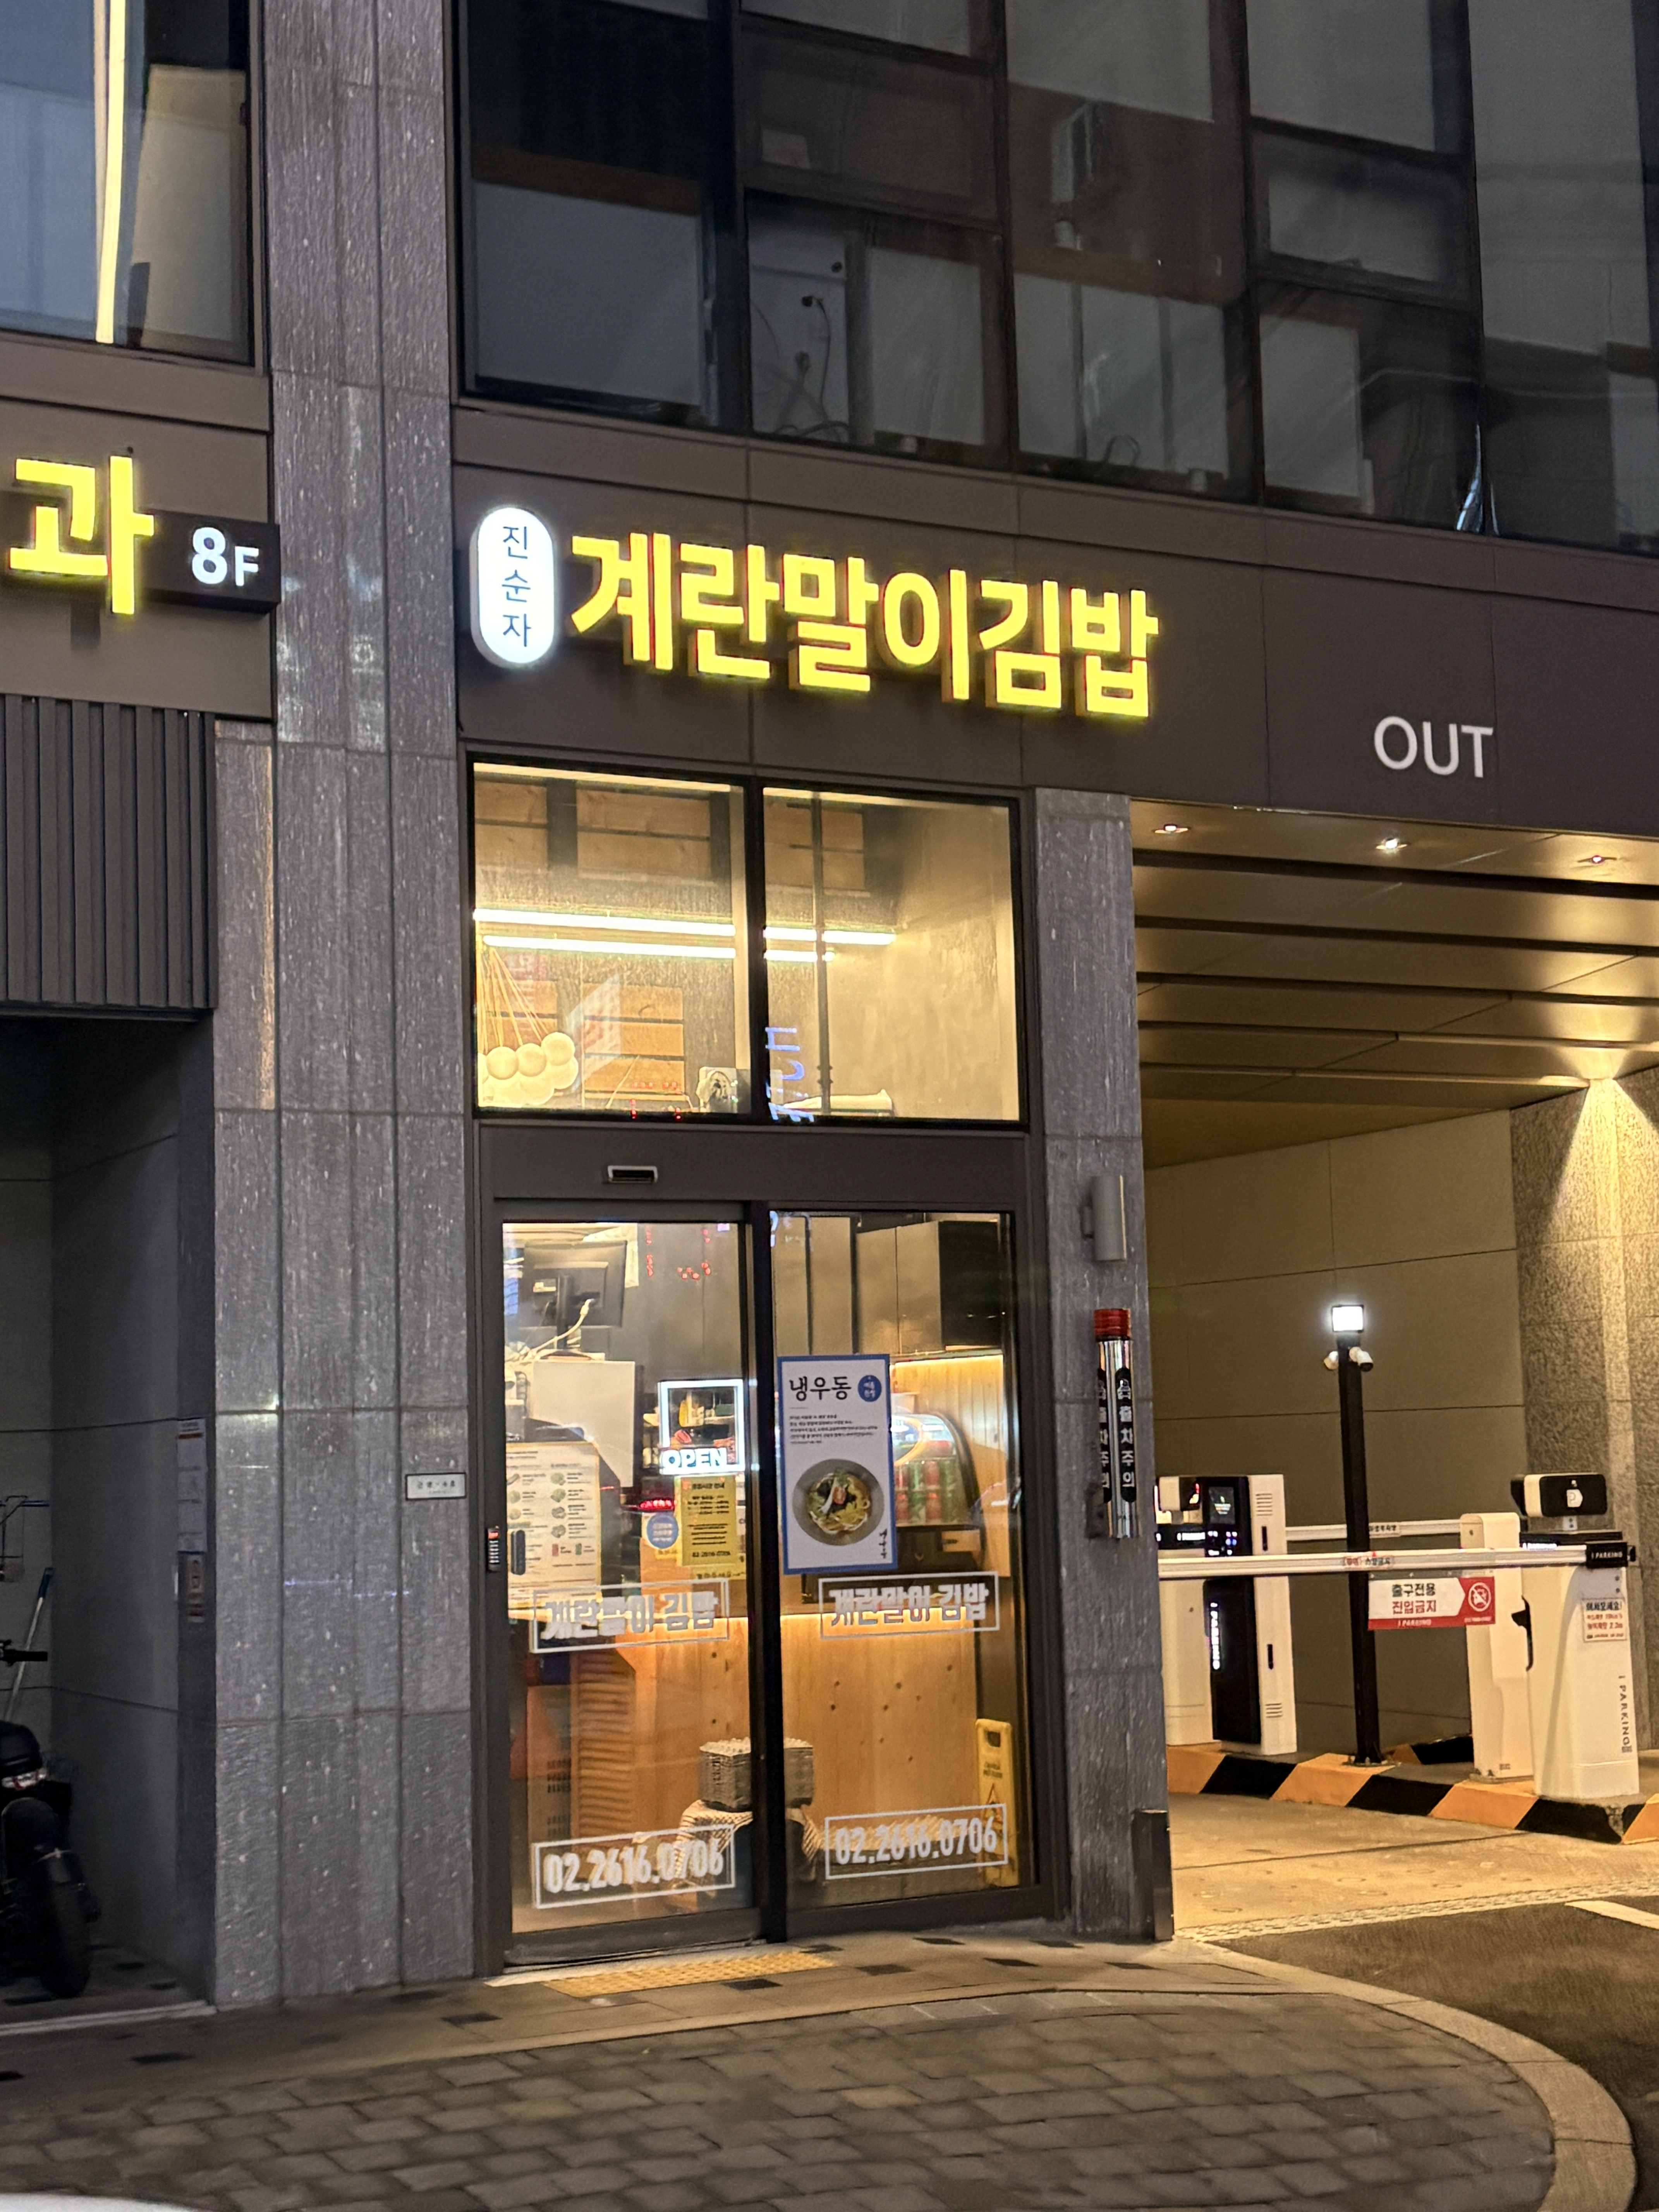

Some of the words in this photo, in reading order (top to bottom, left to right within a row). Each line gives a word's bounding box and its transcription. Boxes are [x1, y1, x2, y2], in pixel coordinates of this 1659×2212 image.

[9, 455, 155, 615] 과
[191, 526, 260, 587] 8F
[501, 524, 532, 648] 진순자
[571, 532, 1158, 718] 계란말이김밥
[1374, 716, 1494, 778] OUT
[789, 1376, 852, 1401] 냉우동
[662, 1448, 727, 1470] OPEN
[664, 1591, 718, 1632] 김밥
[828, 1585, 930, 1626] 계란말이
[938, 1582, 990, 1621] 김밥
[1392, 1583, 1436, 1597] 출구전용
[1392, 1600, 1437, 1614] 진입금지
[1619, 1685, 1630, 1746] PARKING
[544, 1837, 724, 1894] 02.2616.0706
[834, 1816, 998, 1865] 02.2616.0706
